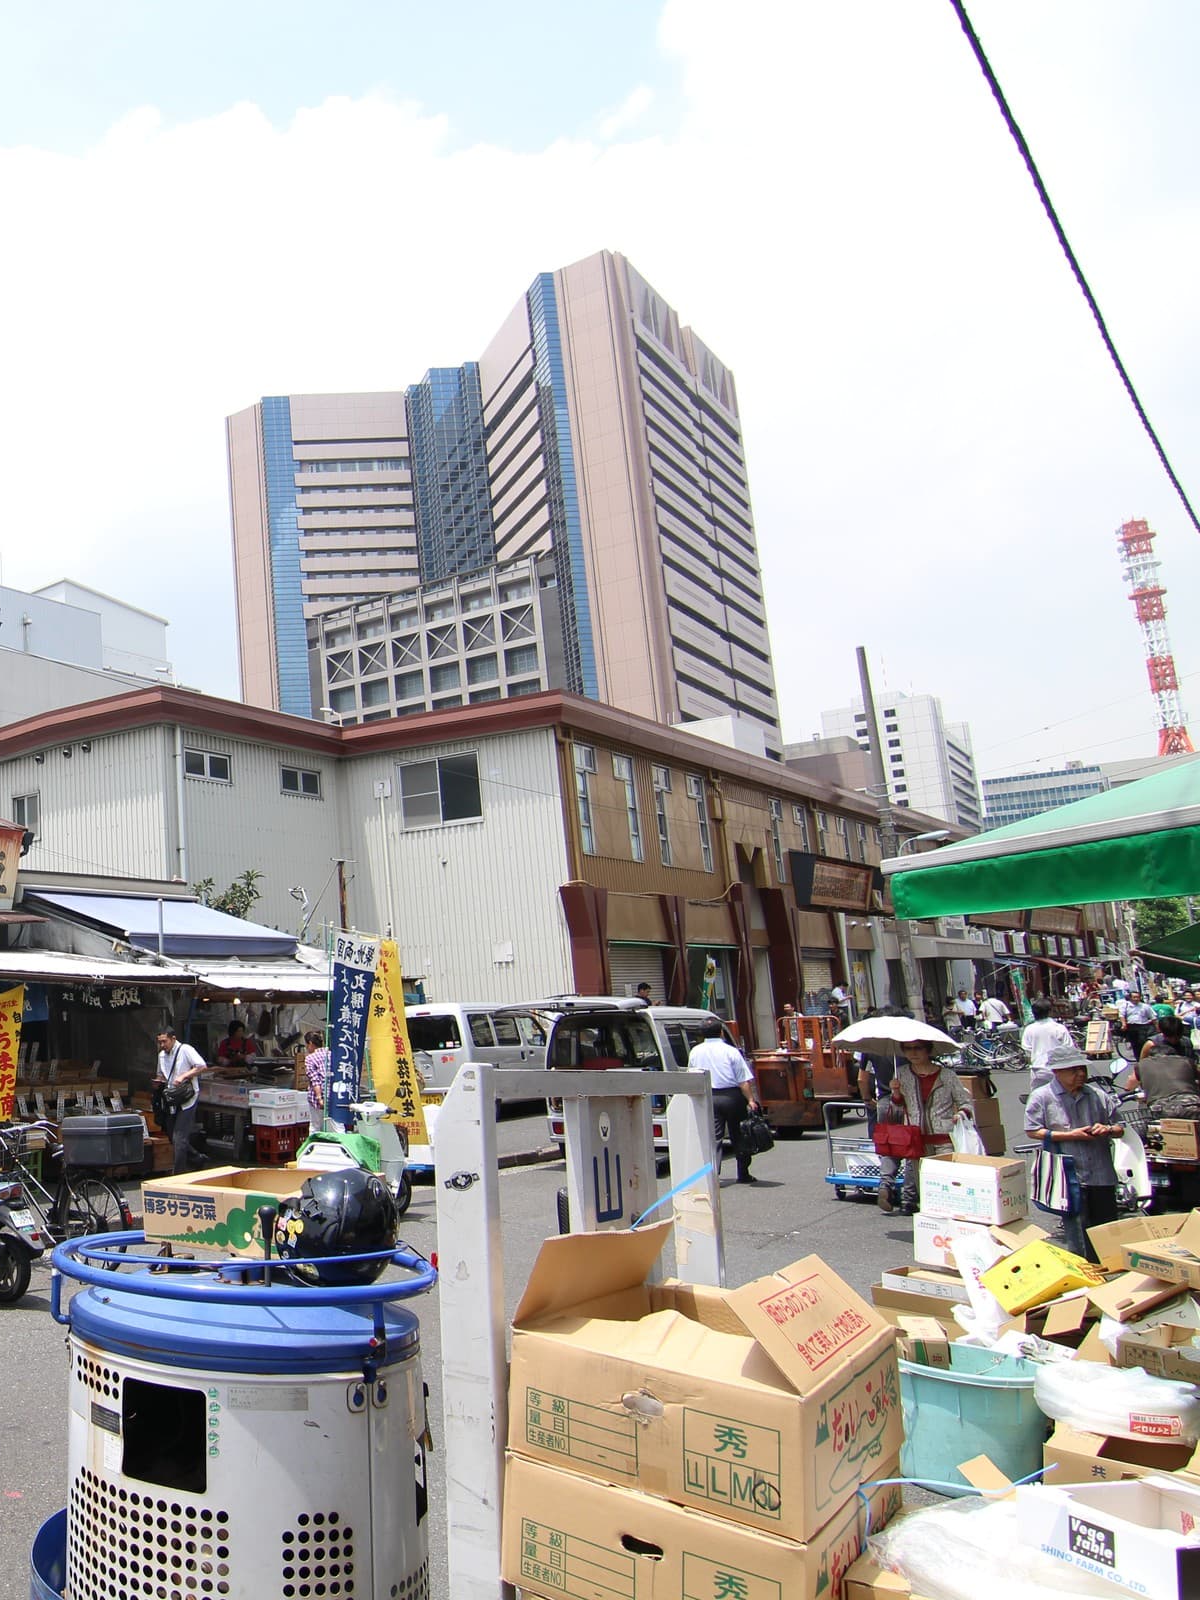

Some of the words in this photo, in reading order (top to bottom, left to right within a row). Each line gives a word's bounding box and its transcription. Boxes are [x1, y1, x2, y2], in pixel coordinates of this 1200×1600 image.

[528, 1391, 566, 1414] 等級
[528, 1410, 566, 1433] 量目
[714, 1424, 748, 1459] 秀
[711, 1466, 728, 1496] L
[733, 1472, 752, 1504] M
[525, 1523, 563, 1547] 等級
[1071, 1518, 1106, 1541] Vege
[524, 1542, 563, 1567] 量目
[1075, 1535, 1113, 1559] table
[1041, 1543, 1073, 1563] SHINO
[1076, 1559, 1104, 1576] FARM
[714, 1570, 748, 1600] 秀
